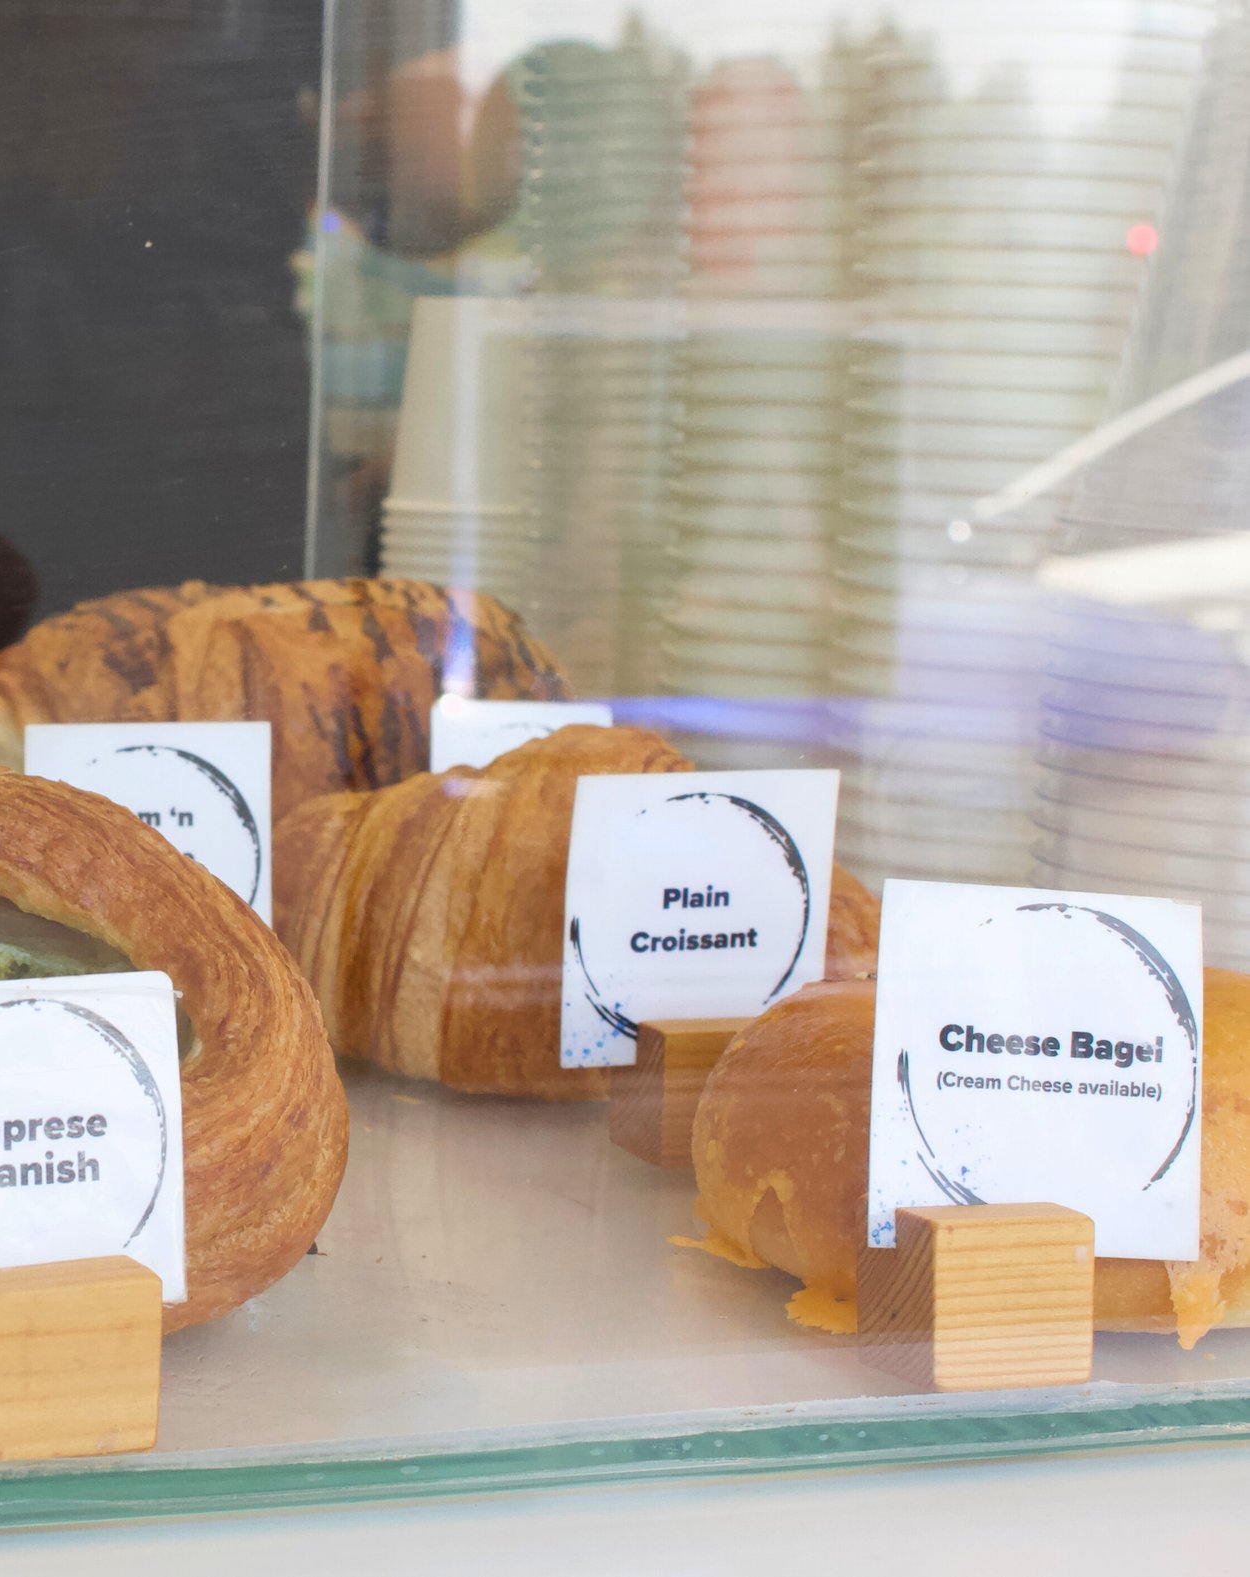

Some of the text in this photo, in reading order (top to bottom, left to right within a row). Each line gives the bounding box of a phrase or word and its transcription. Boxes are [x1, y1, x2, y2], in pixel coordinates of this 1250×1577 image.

[662, 885, 731, 910] Plain
[629, 928, 759, 954] Croissant
[939, 1023, 1164, 1068] Cheese Bagel
[936, 1071, 1163, 1102] (Cream Cheese available)
